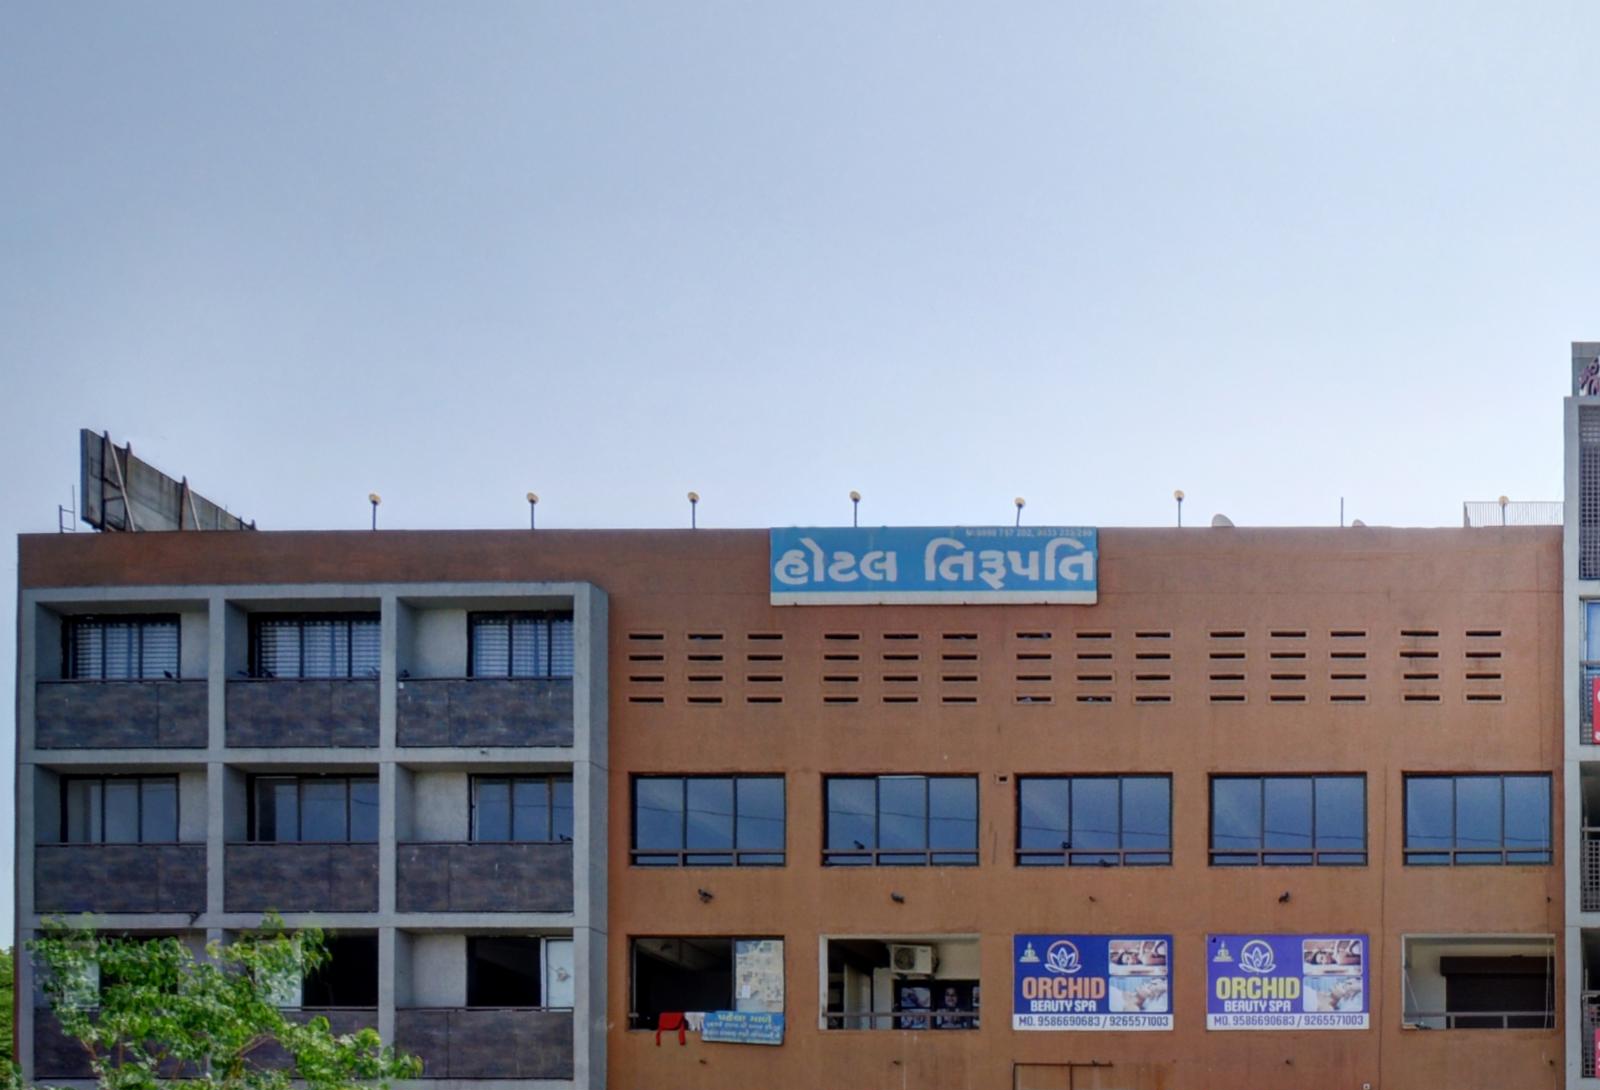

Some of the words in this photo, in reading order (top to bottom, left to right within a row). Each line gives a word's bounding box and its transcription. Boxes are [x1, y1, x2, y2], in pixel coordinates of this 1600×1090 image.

[773, 537, 897, 585] હોટલ
[924, 537, 1095, 590] તિરૂપતિ
[1022, 976, 1106, 1000] ORCHID
[1215, 976, 1300, 1000] ORCHID
[1030, 1000, 1073, 1013] BEAUTY
[1074, 1000, 1097, 1013] SPA
[1224, 1000, 1267, 1013] BEAUTY
[1268, 1000, 1291, 1013] SPA
[1018, 1016, 1036, 1027] MO.
[1038, 1016, 1101, 1027] 9586690683
[1109, 1016, 1169, 1027] 9265571003
[1213, 1016, 1231, 1027] MO.
[1232, 1016, 1296, 1027] 9586690683
[1304, 1016, 1364, 1027] 9265571003
